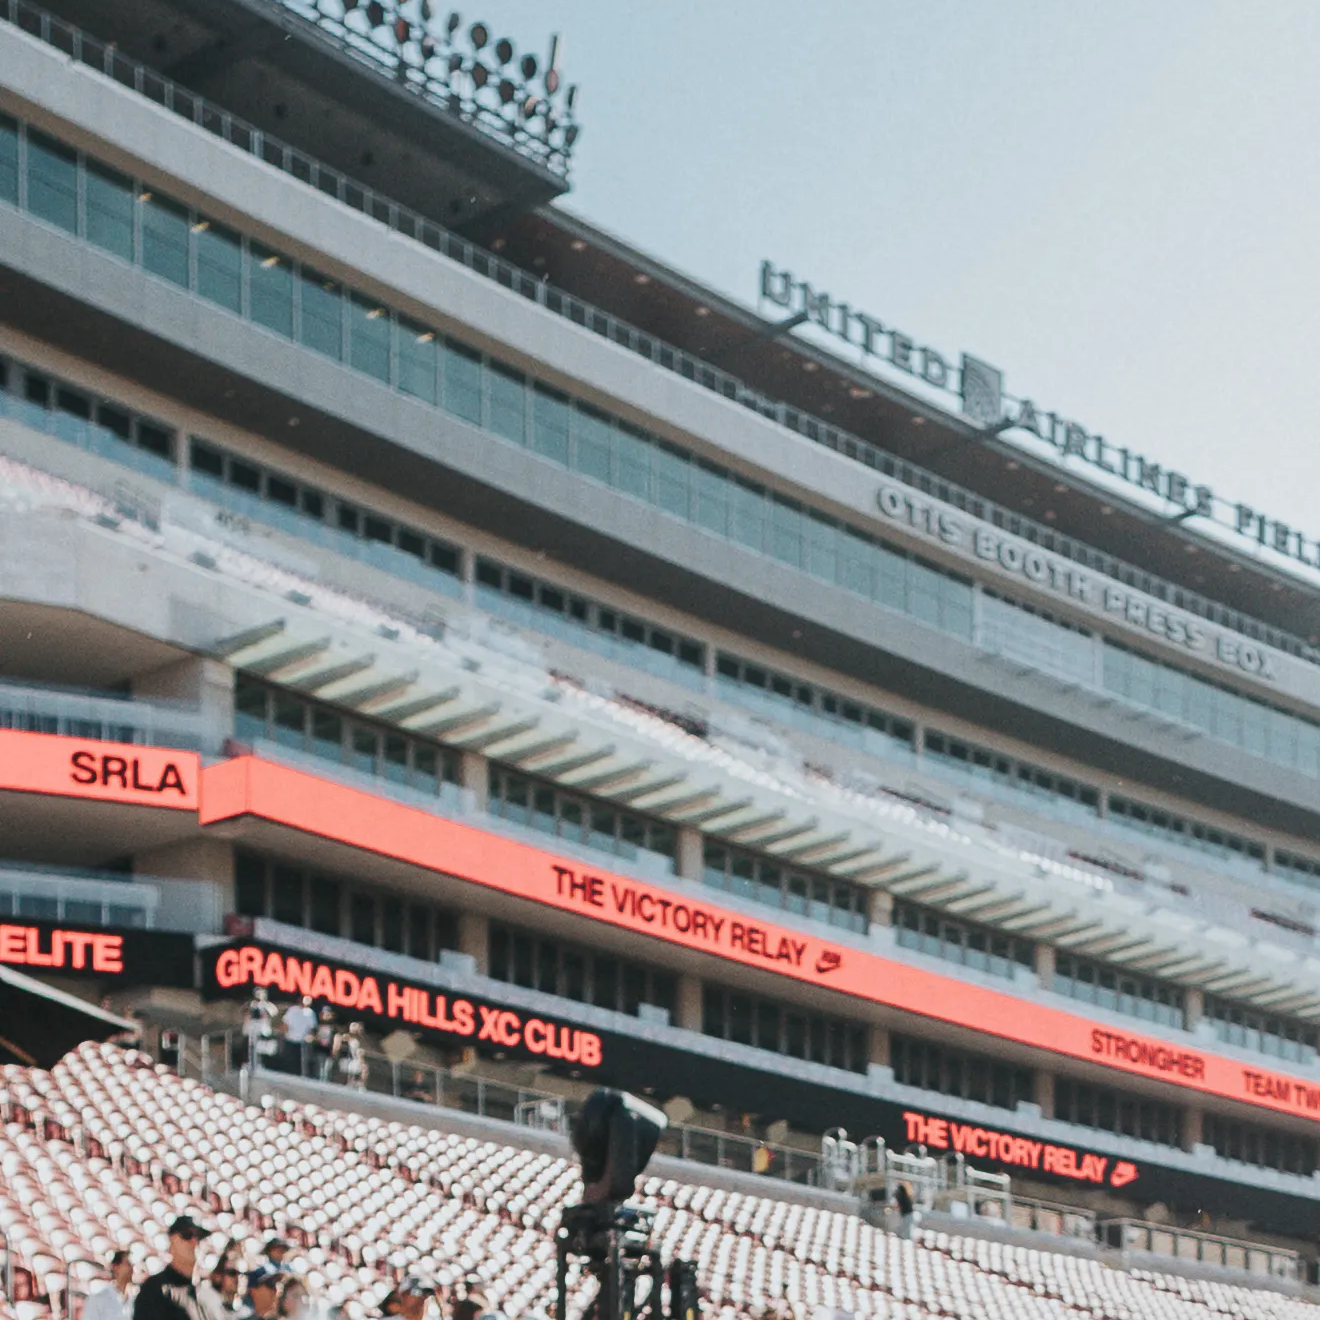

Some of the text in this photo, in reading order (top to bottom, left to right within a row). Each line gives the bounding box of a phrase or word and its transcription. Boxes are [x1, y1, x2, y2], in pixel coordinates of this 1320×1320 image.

[760, 259, 948, 389] UNITED
[1015, 399, 1213, 518] AIRLINES
[877, 485, 1279, 681] OTIS BOOTH PRESS BOX
[70, 751, 187, 795] SRLA
[0, 925, 123, 972] ELITE
[552, 865, 809, 967] THE VICTORY RELAY
[216, 946, 603, 1066] GRANADA HILLS XC CLUB
[1091, 1029, 1206, 1080] STRONGHER
[1241, 1070, 1290, 1101] TEAM
[903, 1111, 1108, 1184] THE VICTORY RELAY
